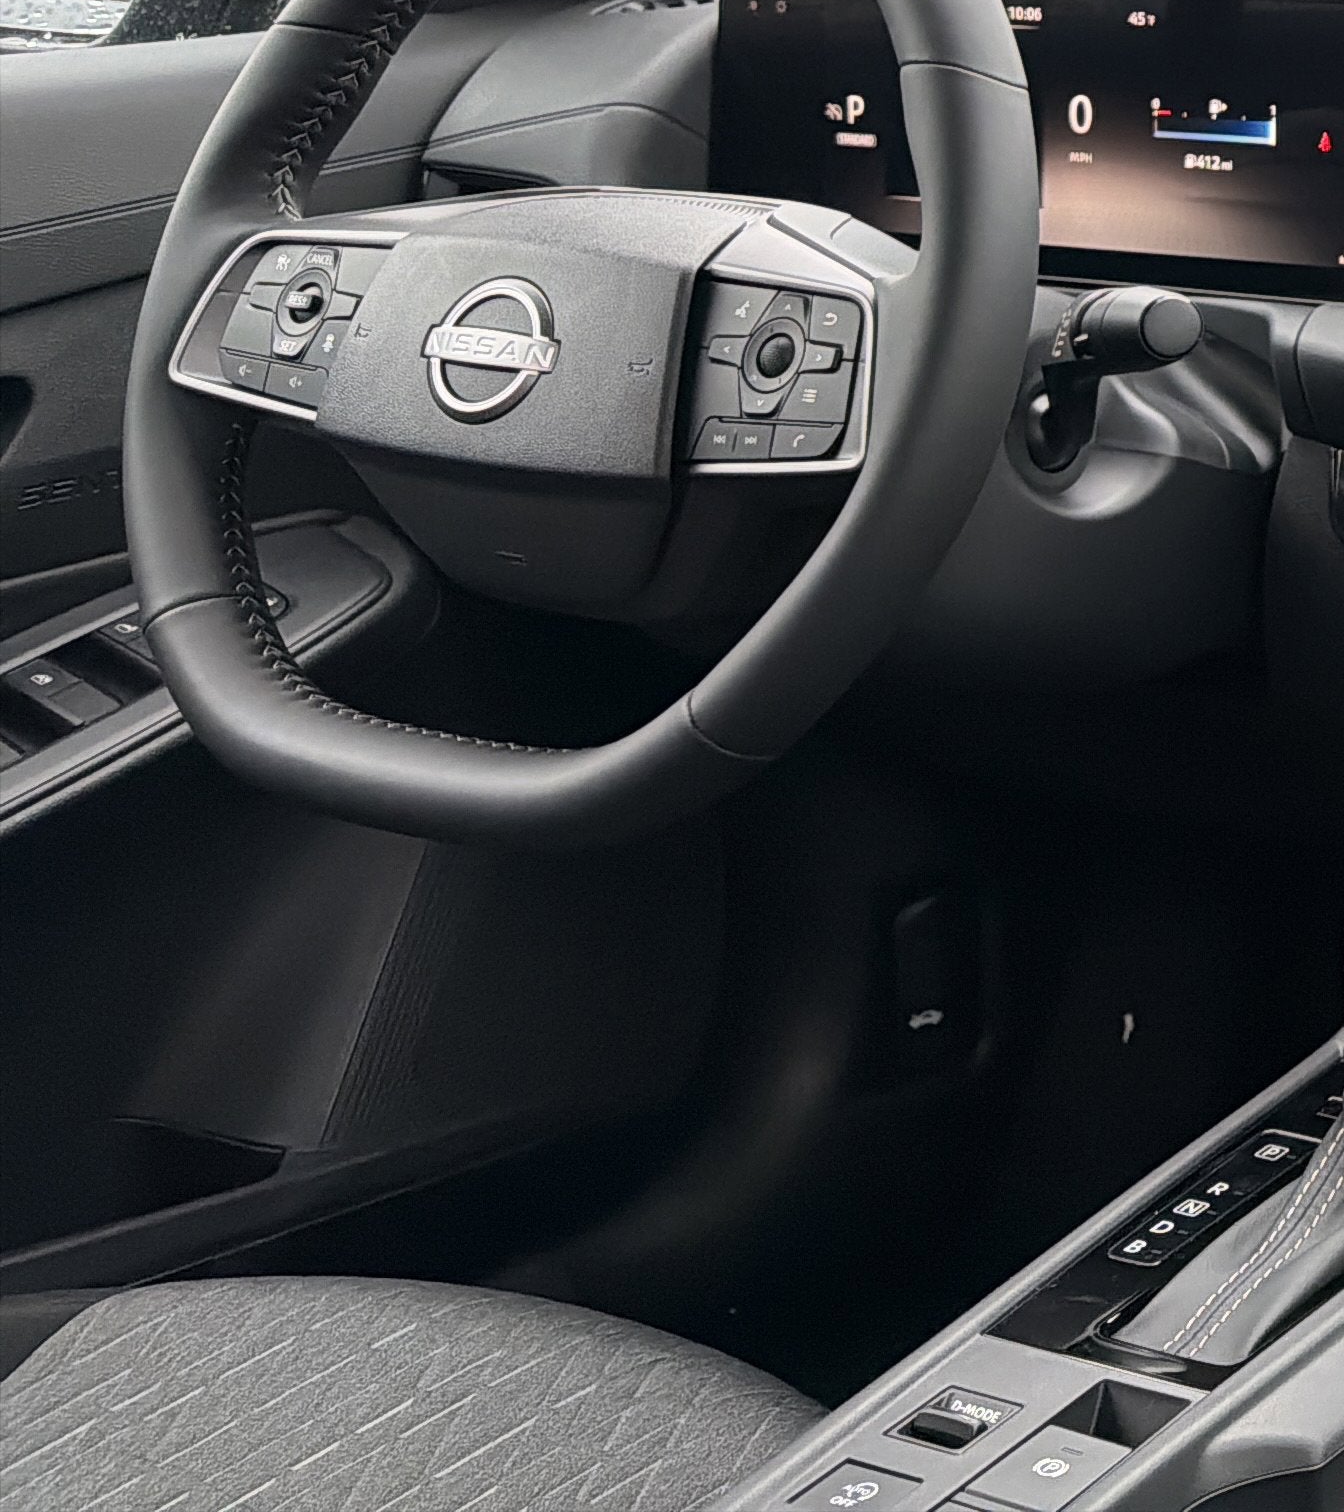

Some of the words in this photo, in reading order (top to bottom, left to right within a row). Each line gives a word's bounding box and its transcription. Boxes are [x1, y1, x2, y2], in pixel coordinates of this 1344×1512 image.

[1007, 6, 1043, 21] 10:06
[846, 94, 865, 125] P
[1068, 94, 1093, 134] 0
[1069, 151, 1093, 164] MPH
[307, 253, 334, 266] CANCEL
[280, 340, 297, 352] SET
[425, 330, 556, 368] NISSAN
[1206, 1182, 1229, 1196] R
[1150, 1221, 1174, 1234] D
[1123, 1240, 1147, 1253] B
[950, 1400, 1001, 1424] D-MODE
[830, 1495, 858, 1508] OFF
